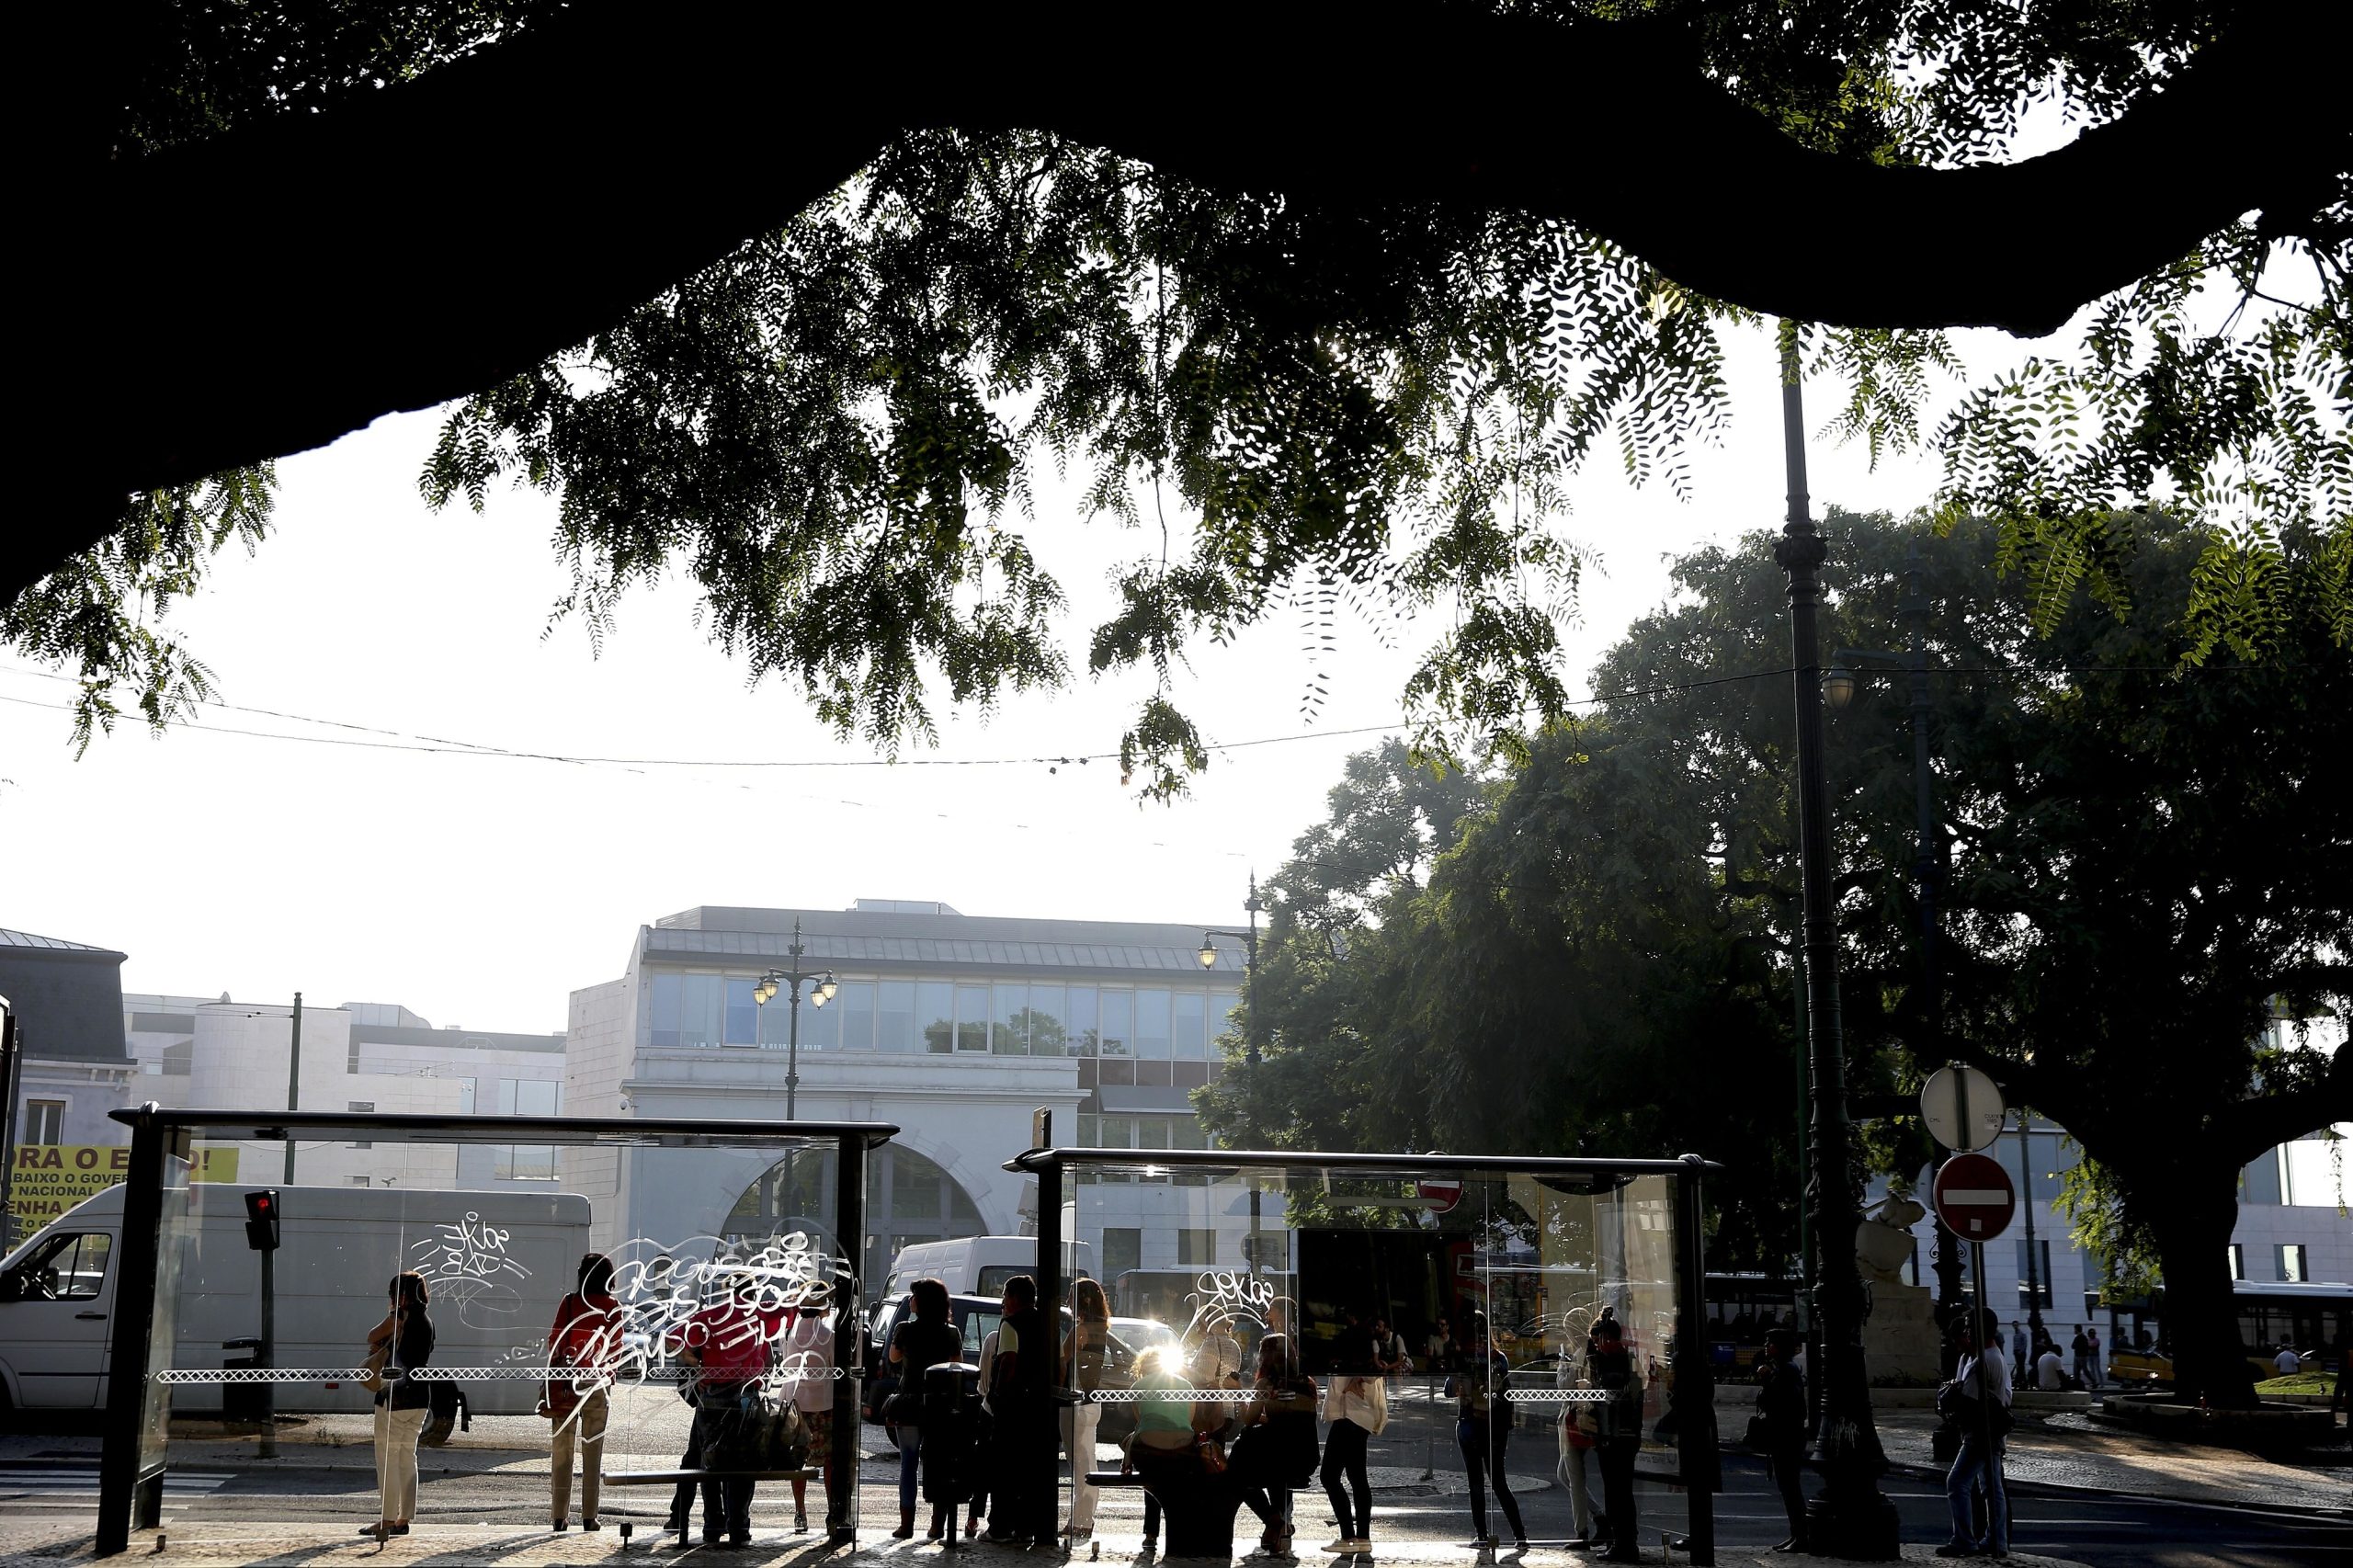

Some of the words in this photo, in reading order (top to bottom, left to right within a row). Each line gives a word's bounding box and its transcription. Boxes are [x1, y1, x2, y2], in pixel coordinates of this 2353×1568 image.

[11, 1148, 63, 1169] RA
[75, 1148, 98, 1169] O
[10, 1173, 60, 1184] BAIXO
[64, 1174, 74, 1184] O
[19, 1186, 94, 1197] NACIONAL
